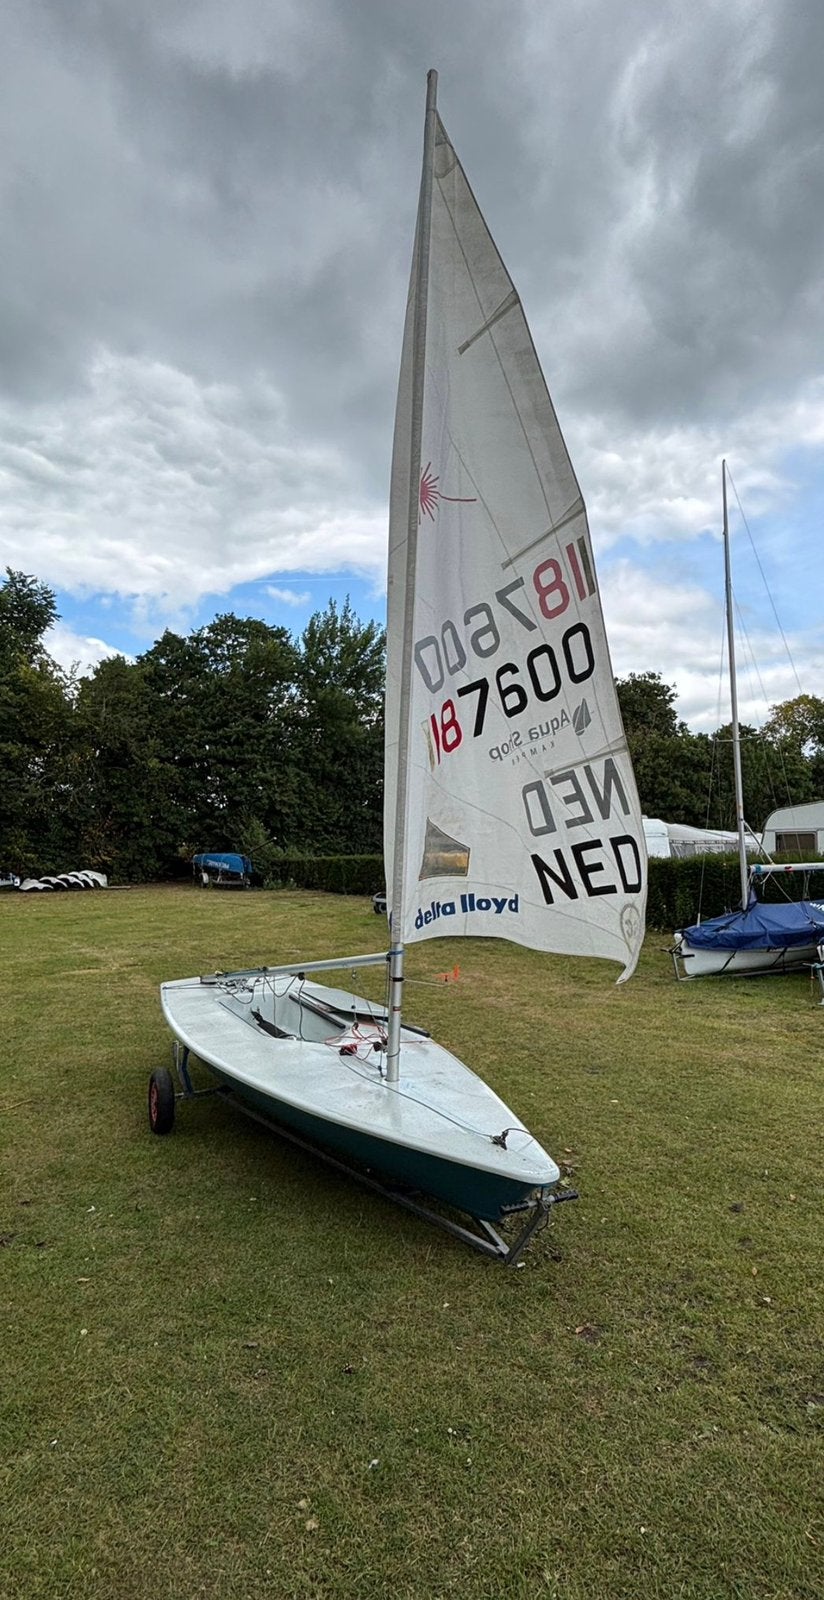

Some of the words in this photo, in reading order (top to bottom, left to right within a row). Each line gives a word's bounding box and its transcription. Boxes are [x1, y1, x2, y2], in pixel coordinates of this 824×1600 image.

[531, 834, 642, 905] NED
[414, 901, 456, 930] delta
[460, 893, 519, 914] lloyd
